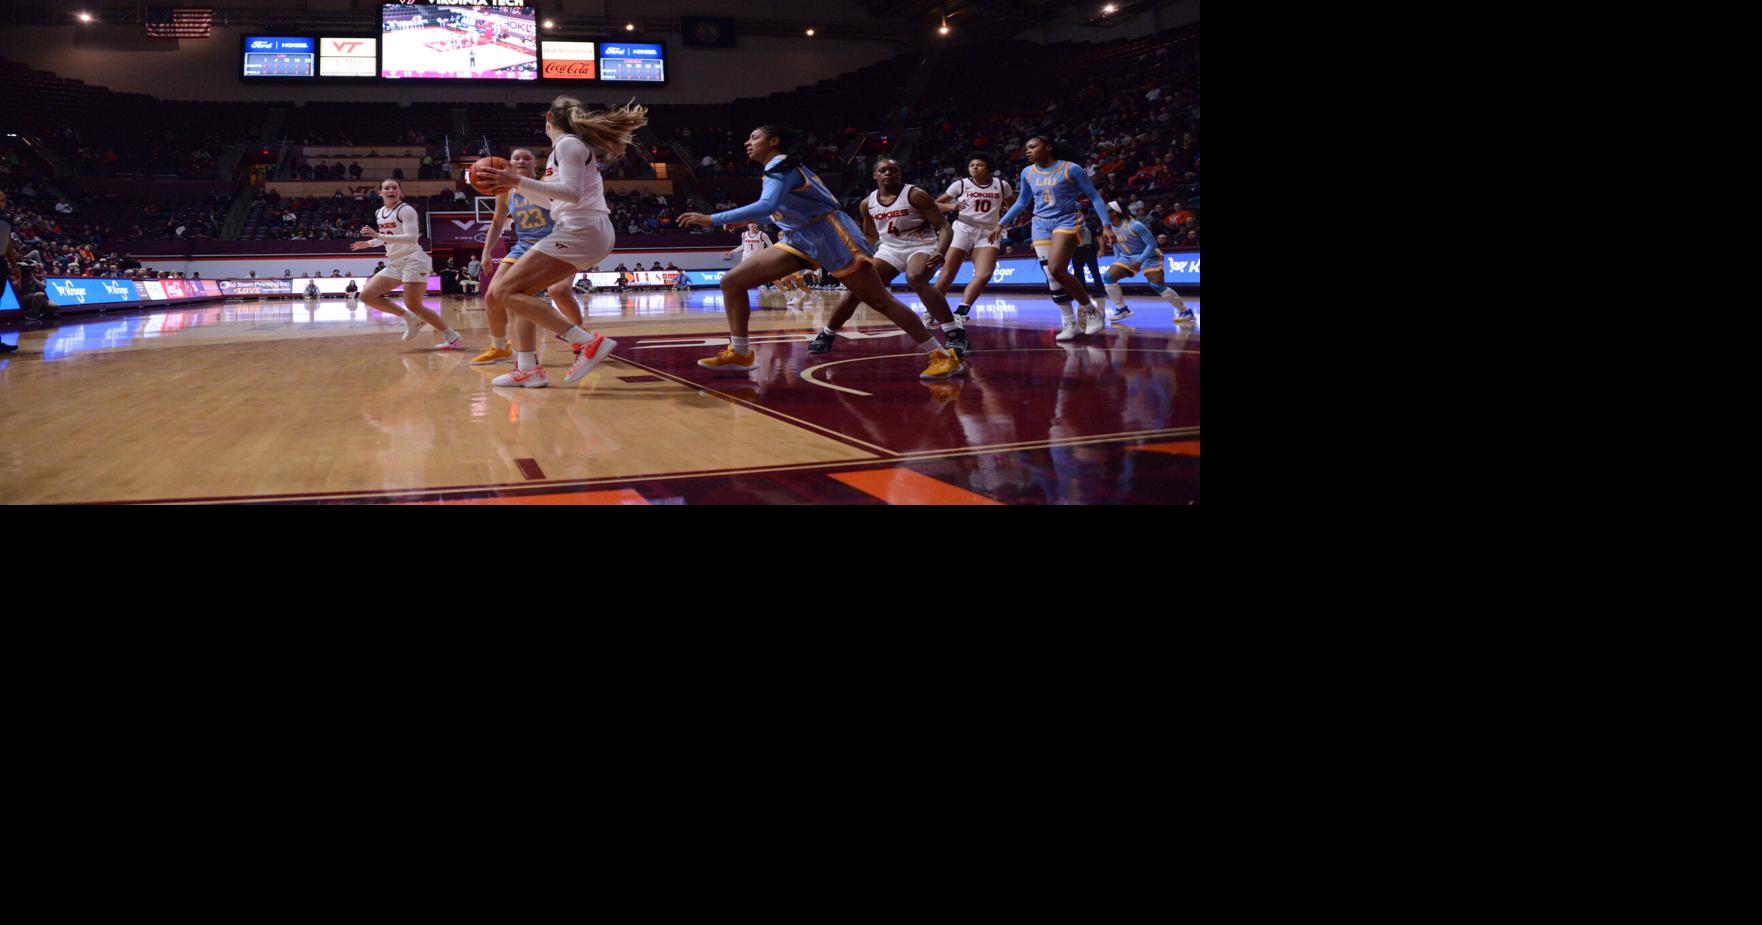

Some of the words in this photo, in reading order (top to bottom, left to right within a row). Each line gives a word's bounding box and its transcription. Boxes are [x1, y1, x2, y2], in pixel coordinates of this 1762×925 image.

[1035, 177, 1057, 186] LIU
[967, 191, 1000, 199] HOKIES
[974, 200, 992, 213] 10
[515, 207, 547, 229] 23
[872, 208, 909, 220] HOKIES
[887, 221, 899, 237] 4
[555, 241, 568, 250] VT
[254, 281, 279, 289] Printing
